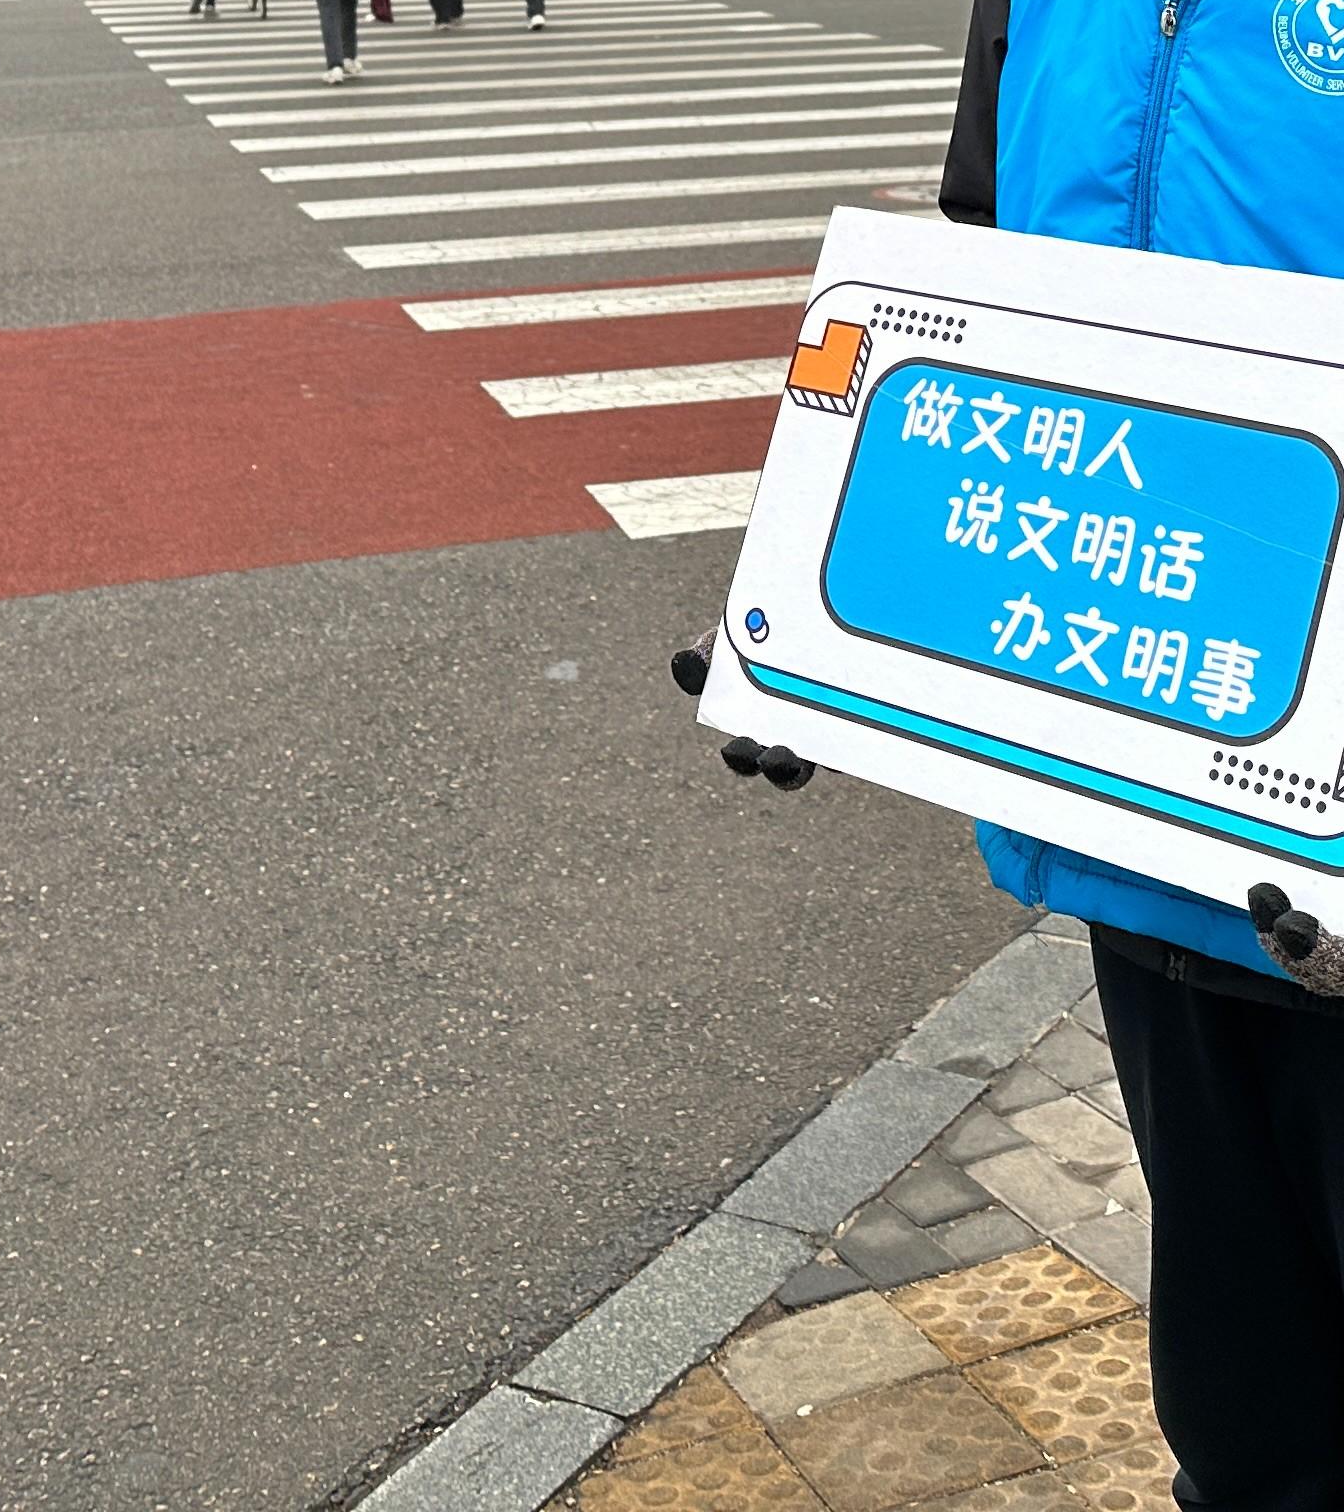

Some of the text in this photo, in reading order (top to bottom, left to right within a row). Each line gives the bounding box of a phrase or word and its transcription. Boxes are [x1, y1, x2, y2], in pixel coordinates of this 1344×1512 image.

[1277, 15, 1292, 50] BEIJING
[1286, 50, 1324, 87] VOLUNTEER
[901, 377, 1144, 490] 做文明人
[944, 477, 1205, 602] 说文明话
[990, 591, 1262, 722] 办文明事
